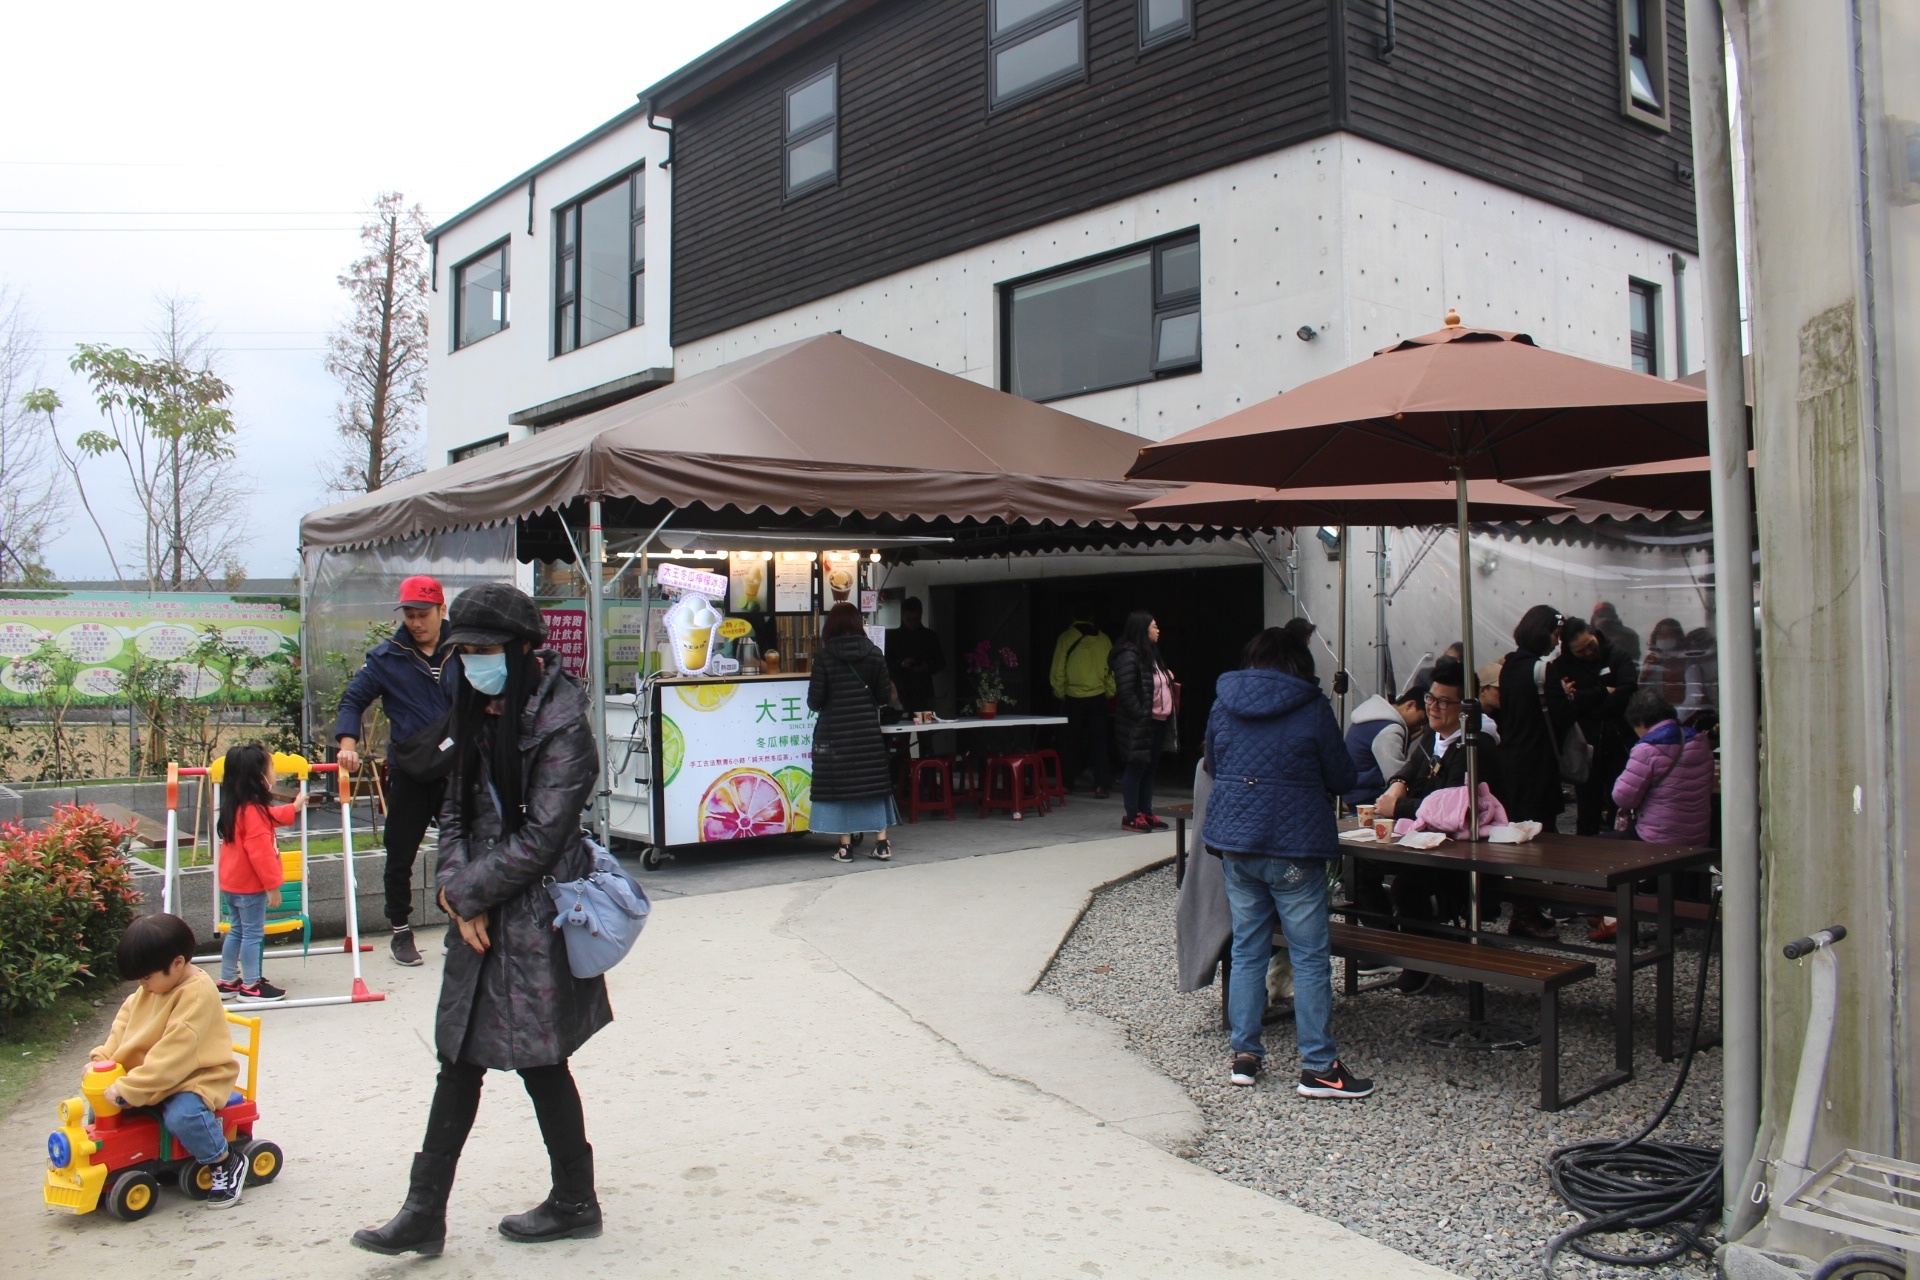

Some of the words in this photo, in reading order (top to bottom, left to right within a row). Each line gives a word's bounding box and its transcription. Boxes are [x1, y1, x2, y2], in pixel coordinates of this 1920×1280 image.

[547, 629, 583, 640] 止飲食
[756, 733, 811, 749] 冬瓜檸檬冰
